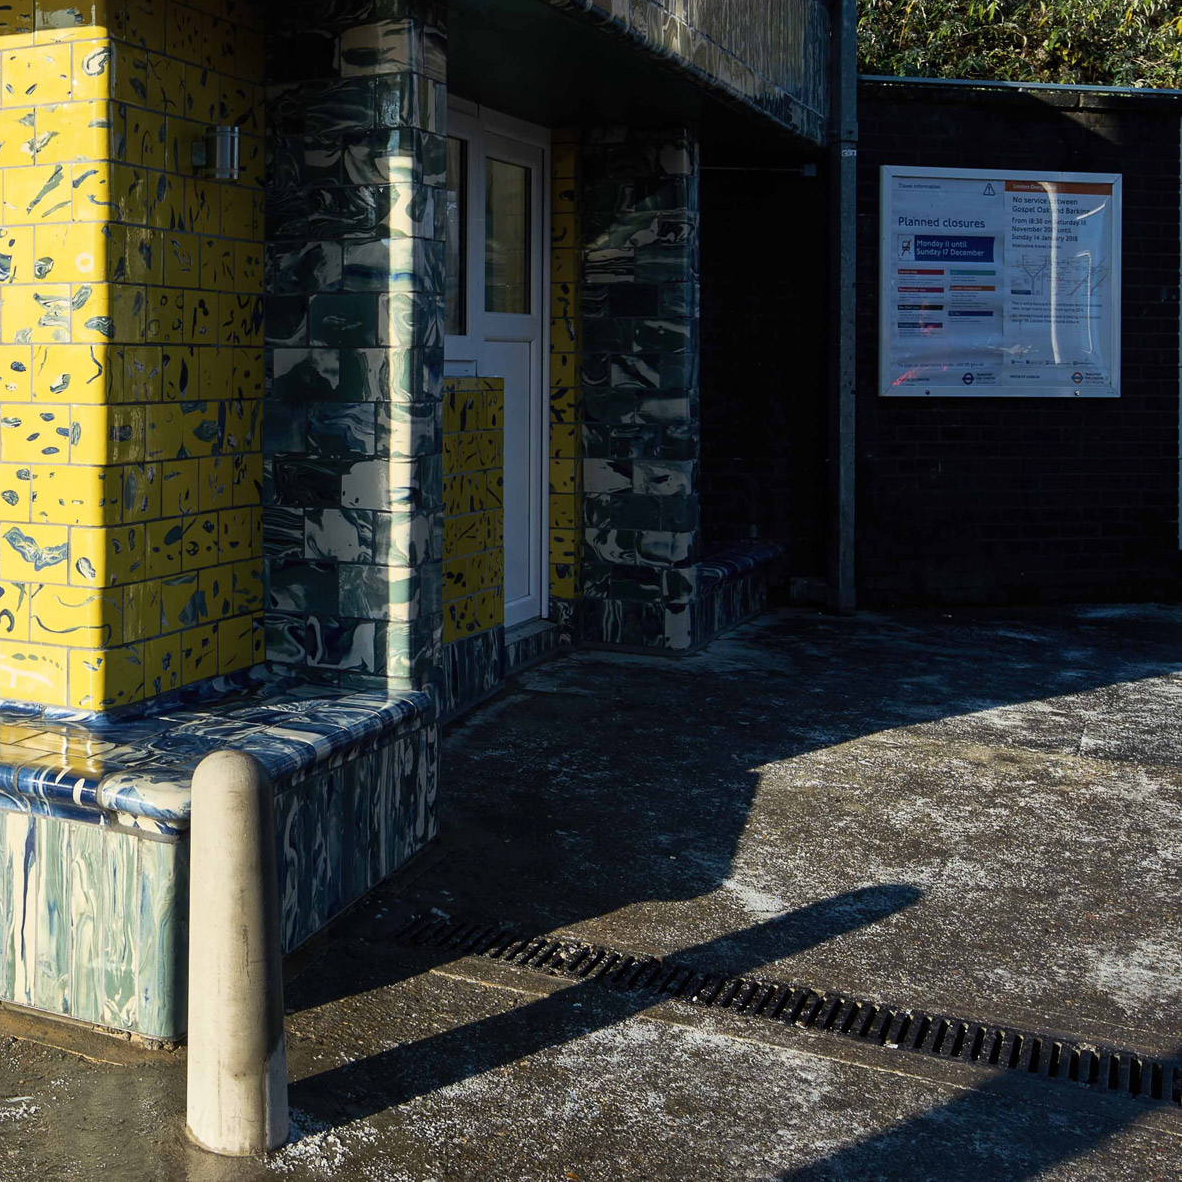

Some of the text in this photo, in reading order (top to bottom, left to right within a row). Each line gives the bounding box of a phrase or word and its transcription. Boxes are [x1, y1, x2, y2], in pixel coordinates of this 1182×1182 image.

[1012, 196, 1023, 204] No
[1024, 197, 1048, 205] service
[1012, 205, 1036, 214] Gospel
[1036, 206, 1051, 214] Oak
[898, 217, 986, 228] Planned closures
[1011, 225, 1043, 233] November
[1011, 234, 1033, 242] Sunday
[916, 240, 944, 248] Monday
[951, 240, 967, 248] until
[916, 248, 942, 257] Sunday
[950, 249, 985, 257] December
